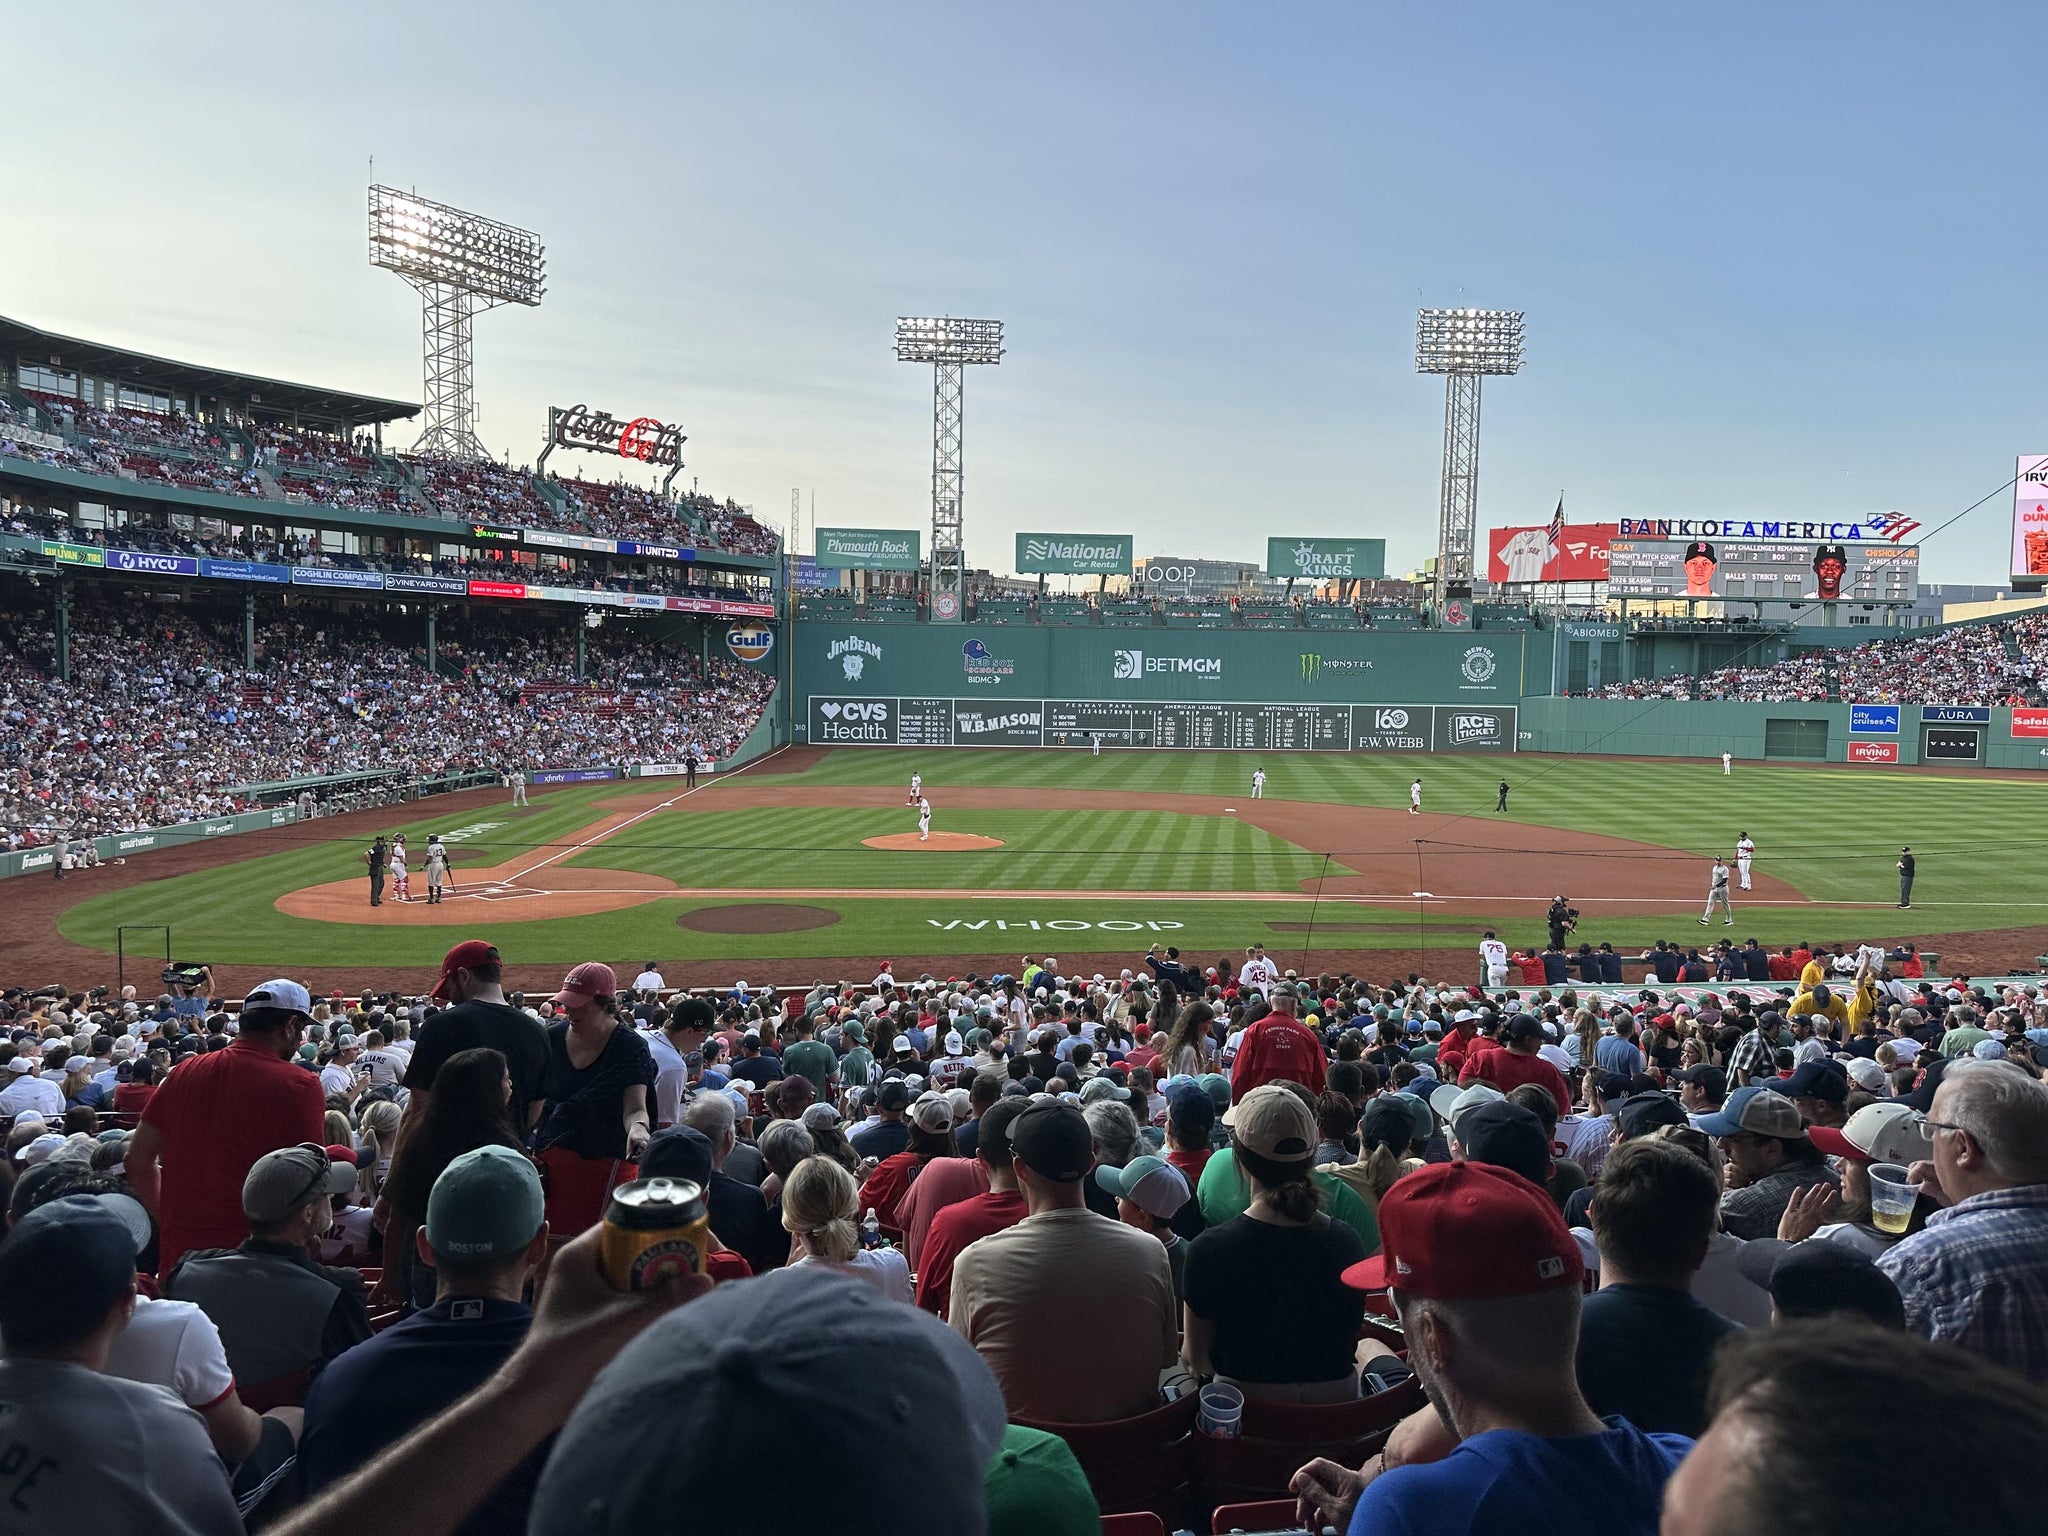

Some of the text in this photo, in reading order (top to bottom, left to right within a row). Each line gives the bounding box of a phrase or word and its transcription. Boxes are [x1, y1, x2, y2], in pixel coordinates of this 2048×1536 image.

[2025, 472, 2048, 482] IRV
[1619, 518, 1861, 540] BANK OF AMERICA
[475, 529, 518, 541] DRAFTKINGS
[645, 545, 679, 558] UNITED
[827, 539, 909, 553] Plymouth Rock
[1527, 547, 1541, 556] SOX
[1612, 543, 1635, 551] GRAY
[44, 546, 102, 563] SULLIVAN TIRE
[1865, 549, 1904, 557] CHISHOLM
[138, 556, 178, 570] HYCU
[1073, 560, 1088, 568] Car
[1294, 553, 1355, 566] DRAFT
[1302, 564, 1353, 575] KINGS
[294, 569, 382, 582] COGHLIN COMPANIES
[395, 579, 463, 590] VINEYARD VINES
[1573, 629, 1619, 637] ABIOMED
[728, 632, 770, 646] Gulf
[827, 635, 883, 662] JIM BEAM
[1464, 646, 1494, 658] IBEW 103
[969, 659, 1014, 668] RED SOX
[1146, 658, 1221, 673] BETMGM
[1323, 660, 1374, 670] MONSTER
[968, 667, 1014, 675] SCHOLARS
[968, 676, 992, 684] BIDMC
[842, 703, 888, 721] CVS
[1853, 711, 1870, 719] city
[1375, 709, 1409, 729] 160
[1459, 716, 1495, 729] ACE
[2013, 717, 2048, 726] Safeli
[822, 722, 888, 740] Health
[1459, 728, 1495, 738] TICKET
[1359, 737, 1424, 748] F.W. WEBB
[1855, 748, 1890, 756] IRVING
[544, 773, 565, 782] xfinity
[217, 824, 234, 834] TICKET
[120, 836, 155, 850] smartwater
[436, 849, 443, 857] 13
[926, 919, 1185, 932] WHOOP
[1487, 944, 1503, 953] 75
[1251, 971, 1267, 983] 43
[865, 1060, 876, 1084] 16
[943, 1063, 965, 1073] BETTS
[448, 1241, 493, 1254] BOSTON
